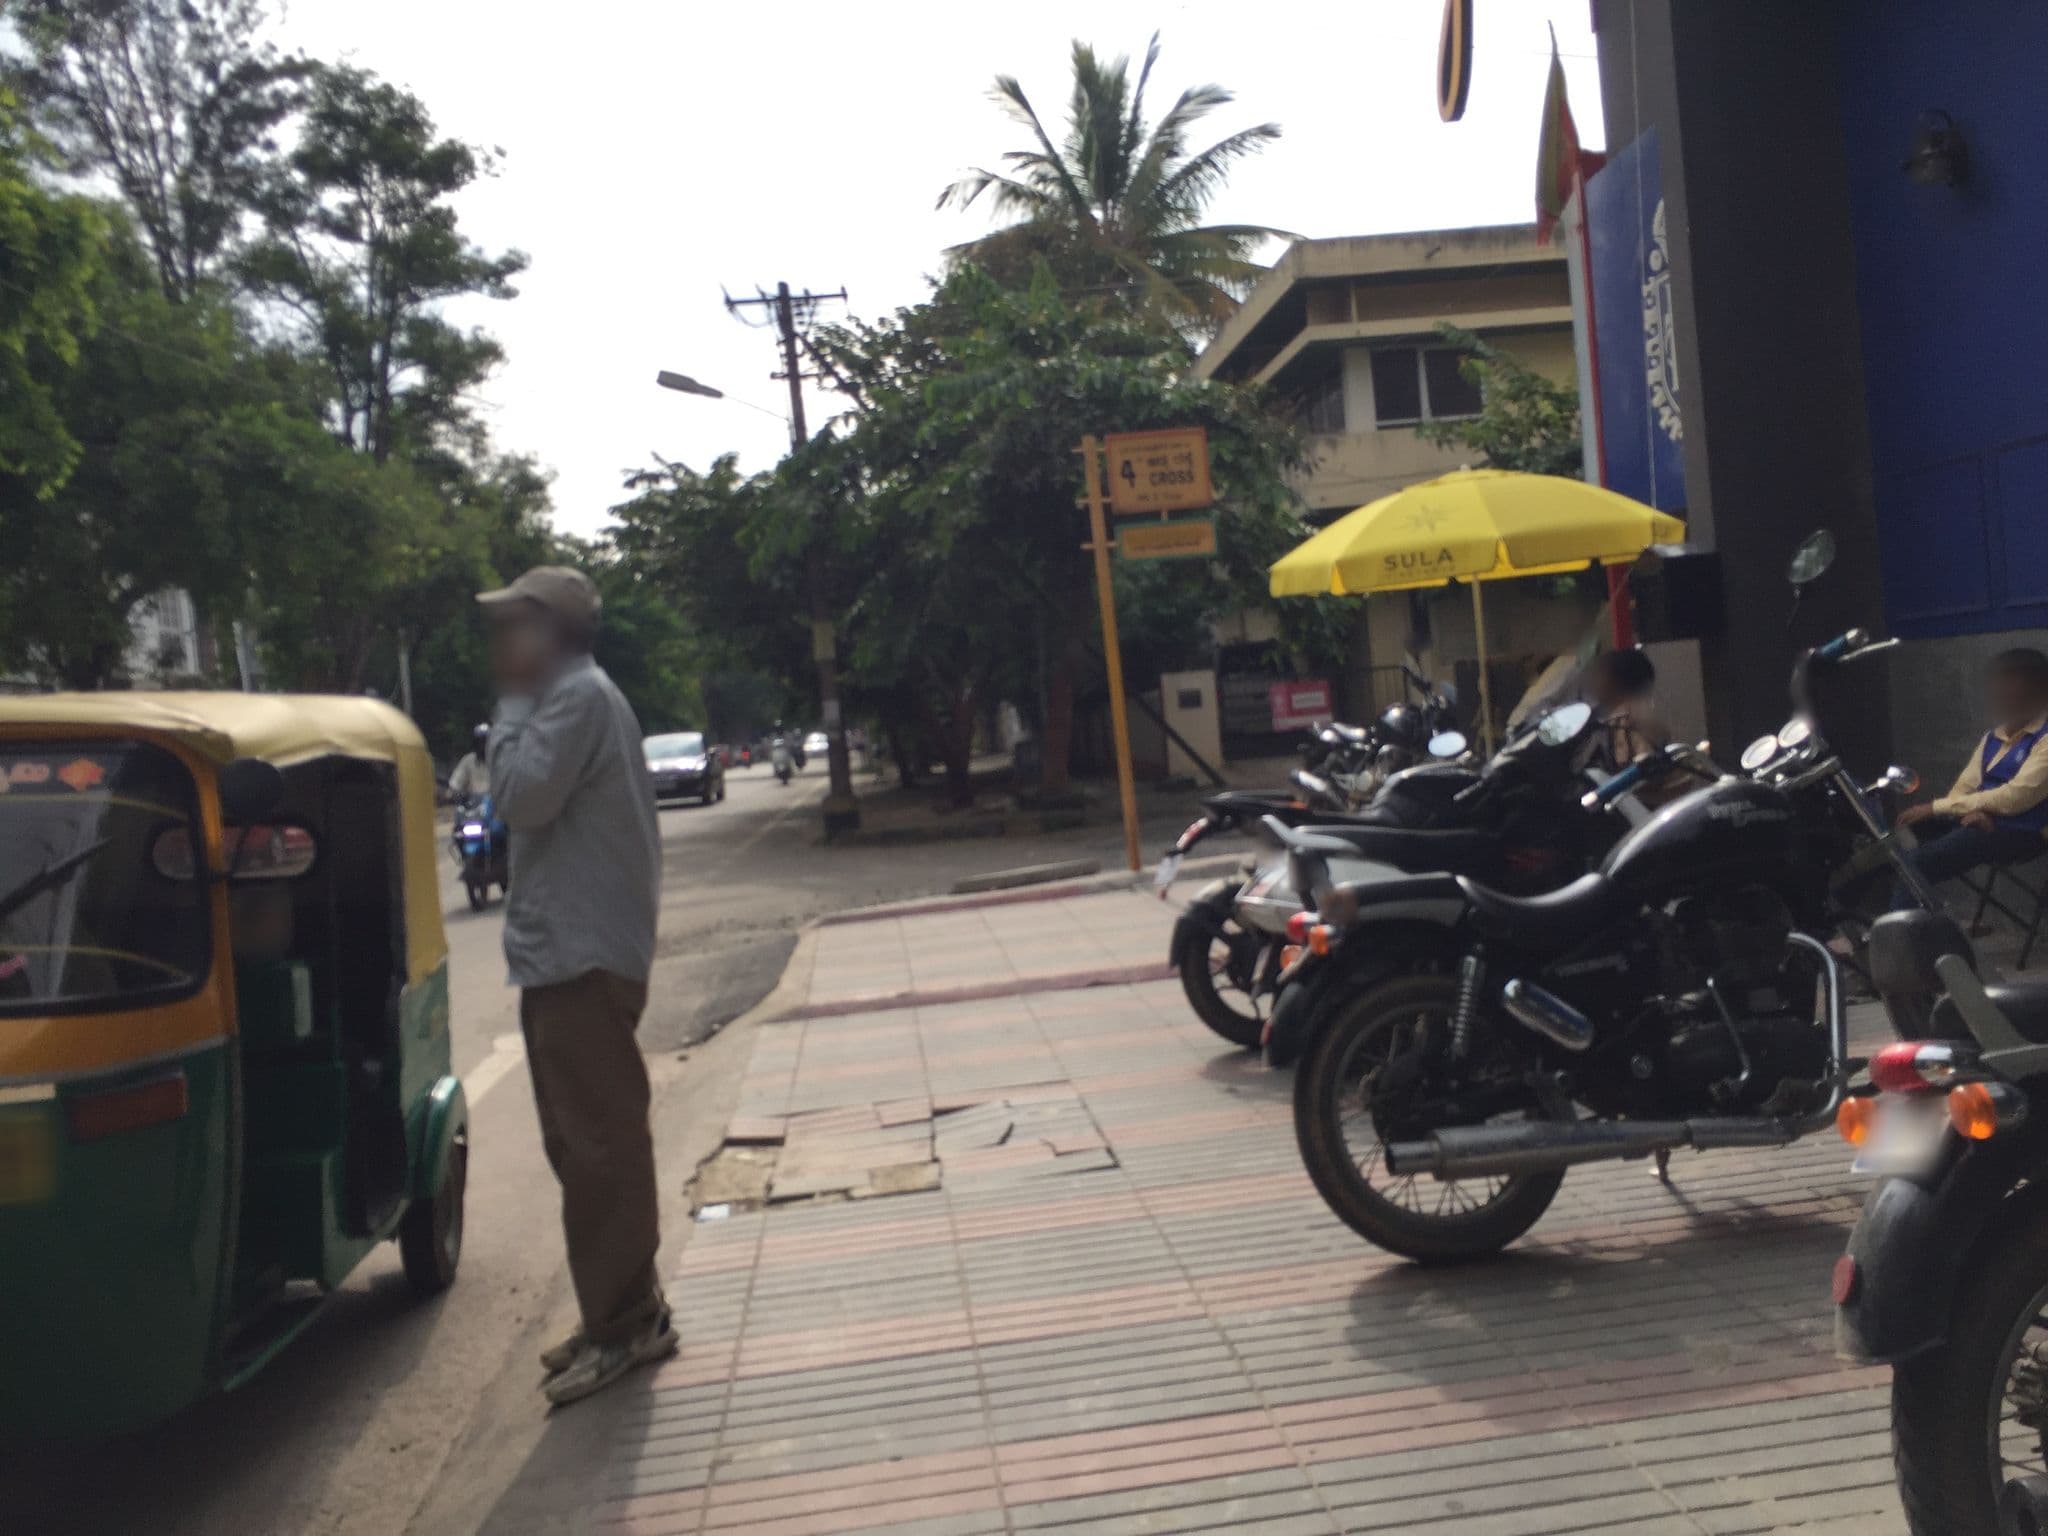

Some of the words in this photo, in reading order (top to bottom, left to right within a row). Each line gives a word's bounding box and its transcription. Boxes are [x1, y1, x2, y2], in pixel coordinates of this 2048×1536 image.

[1121, 459, 1136, 488] 4
[1150, 469, 1194, 486] CROSS
[1384, 549, 1453, 570] SULA
